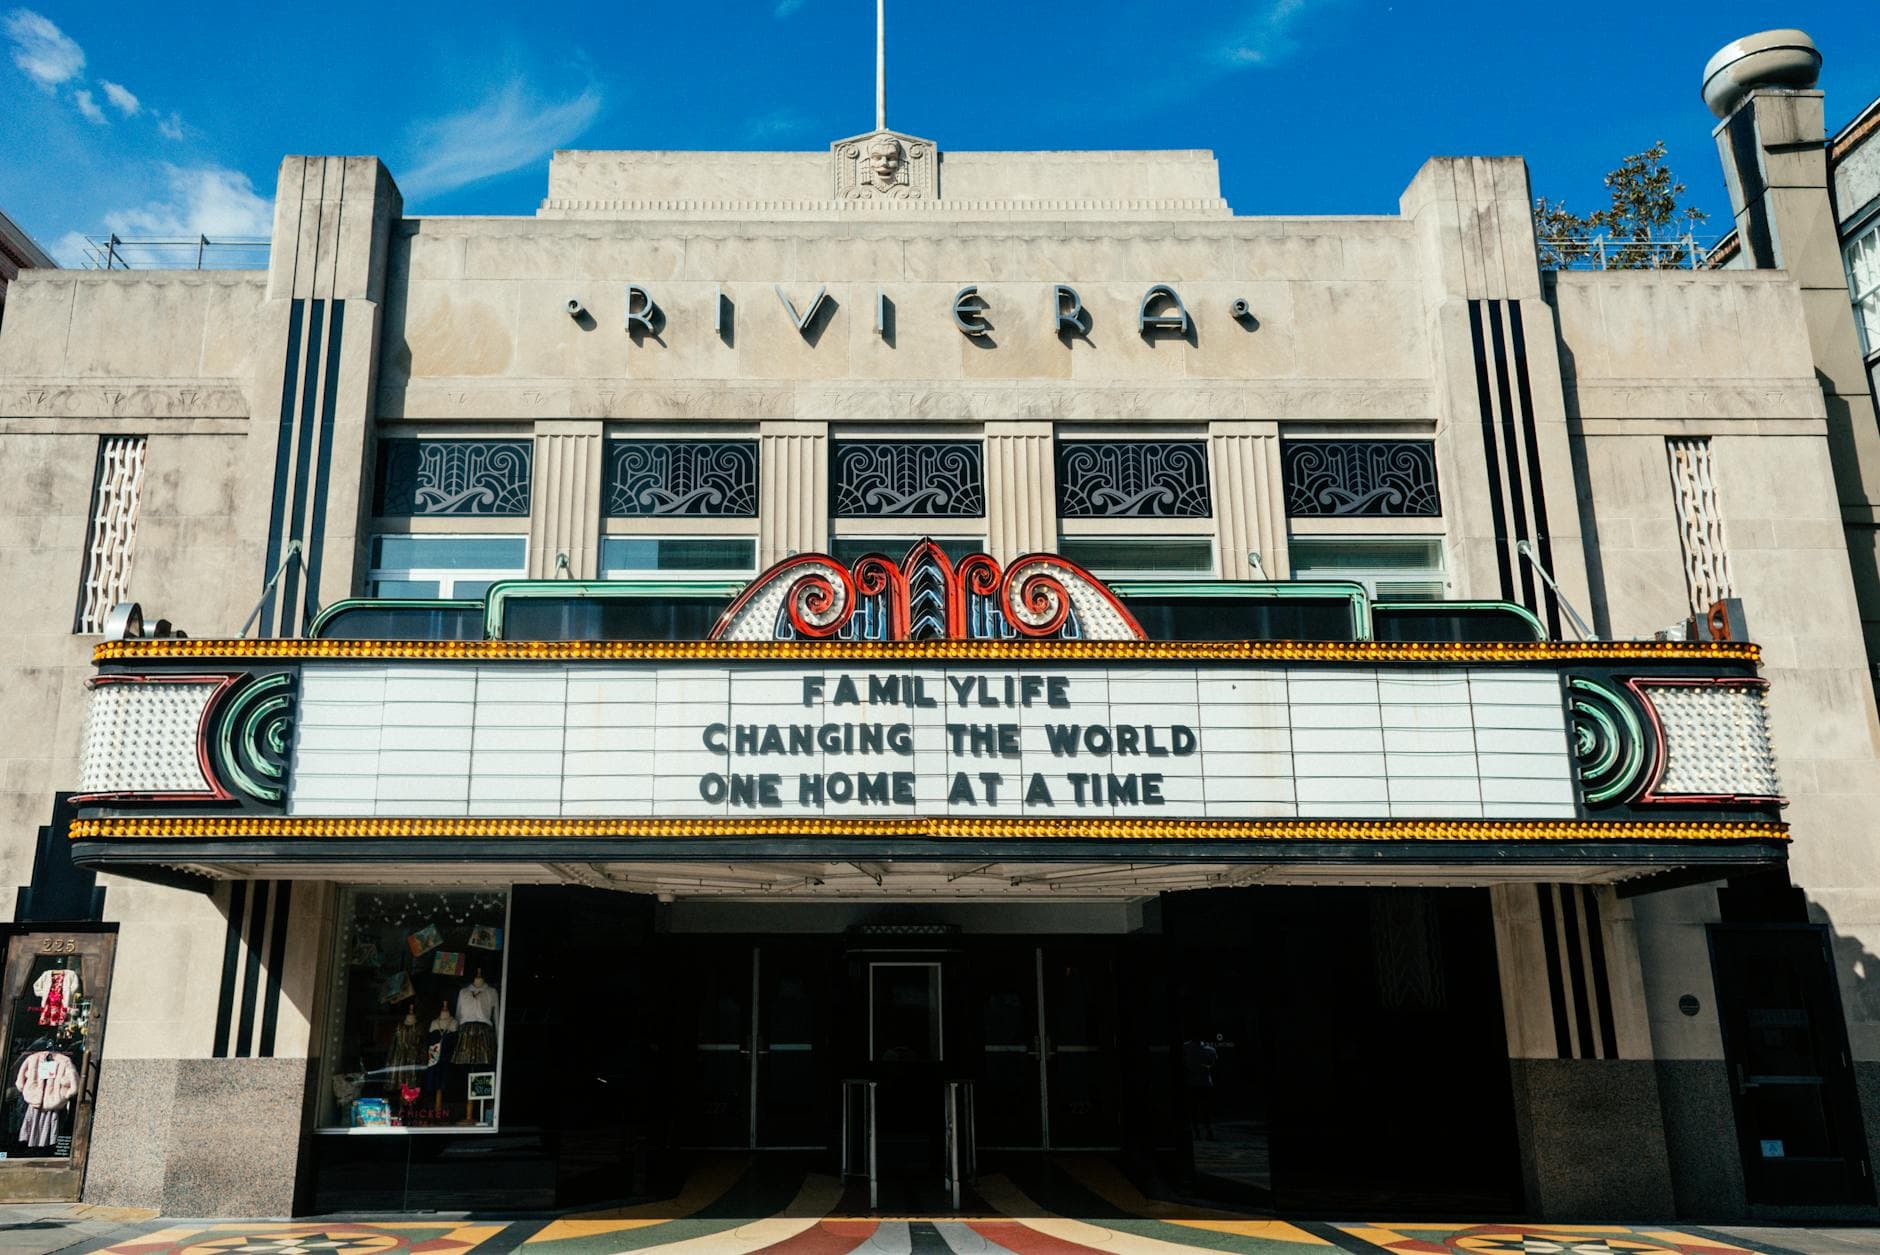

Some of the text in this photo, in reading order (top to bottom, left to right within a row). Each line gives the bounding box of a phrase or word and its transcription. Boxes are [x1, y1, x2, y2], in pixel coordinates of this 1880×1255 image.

[625, 284, 1189, 335] RIVIERA
[803, 674, 1070, 707] FAMILYLIFE
[702, 722, 1198, 756] CHANGING THE WORLD
[699, 771, 1166, 807] ONE HOME AT A TIME
[42, 937, 76, 953] 225
